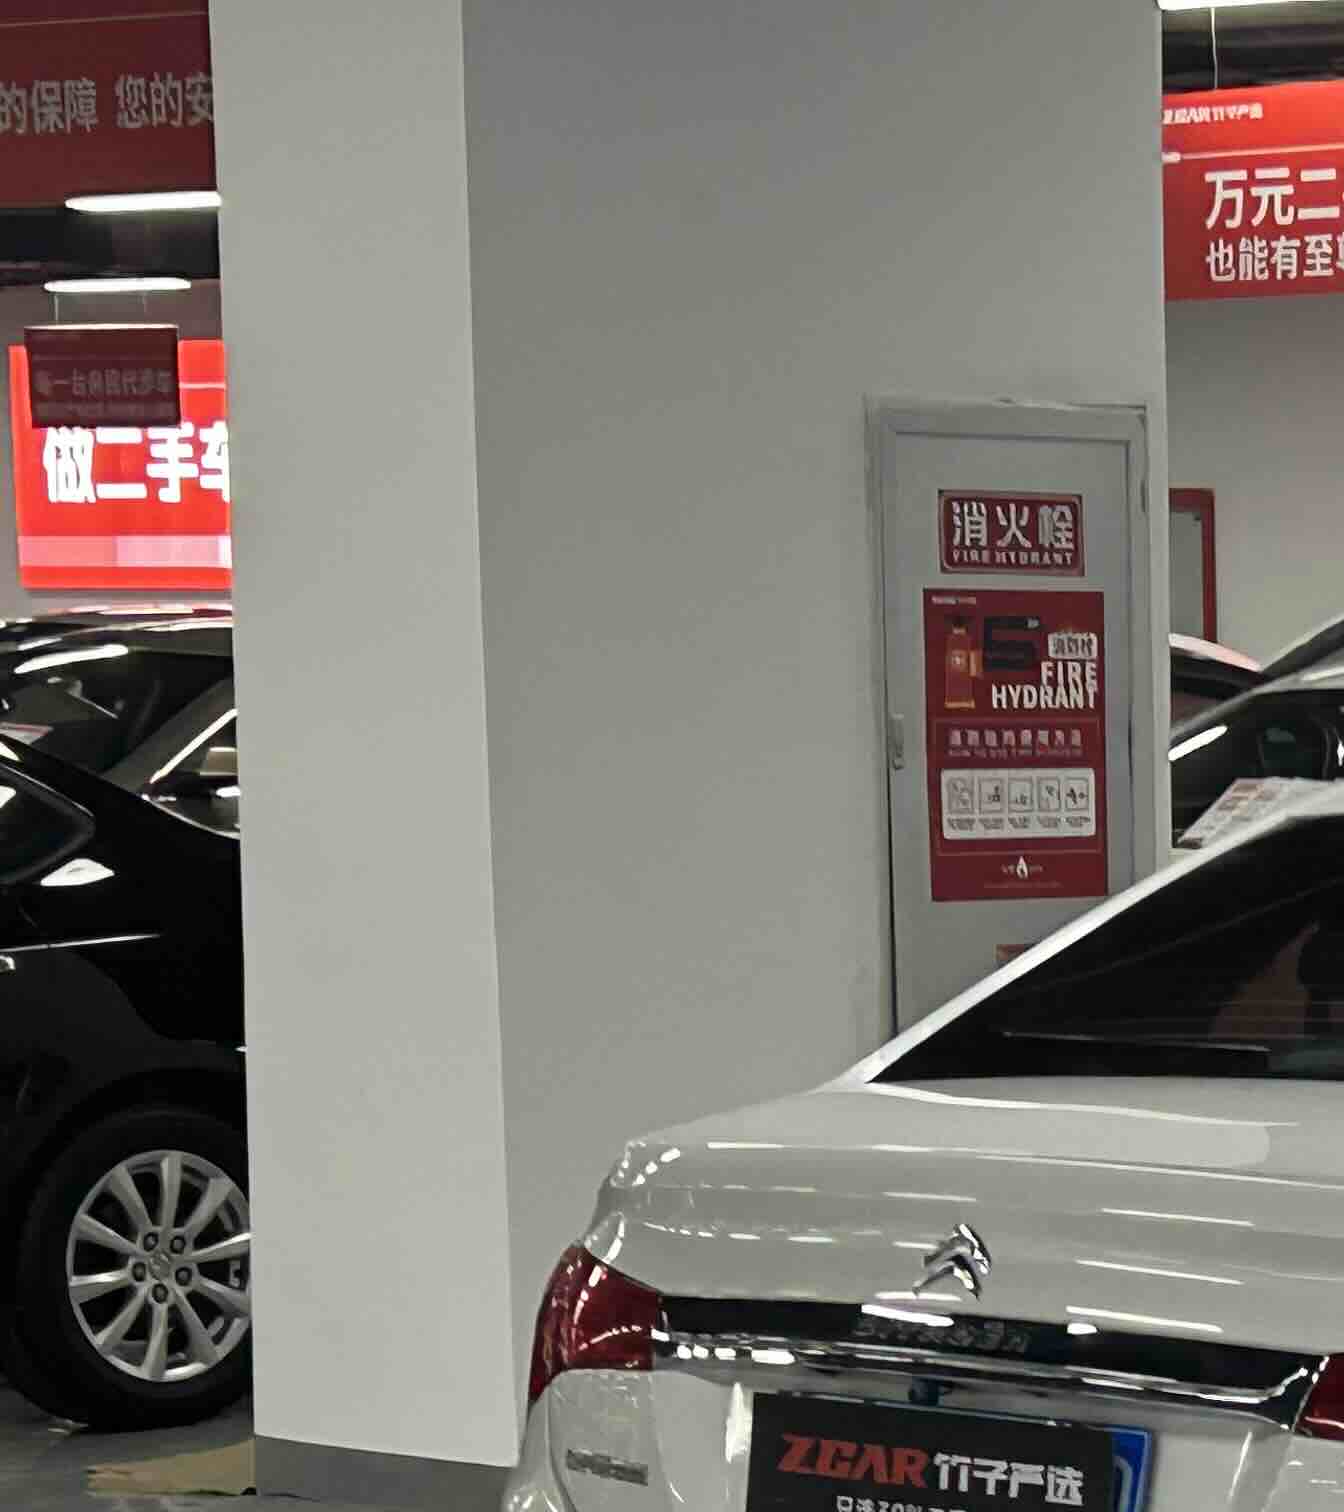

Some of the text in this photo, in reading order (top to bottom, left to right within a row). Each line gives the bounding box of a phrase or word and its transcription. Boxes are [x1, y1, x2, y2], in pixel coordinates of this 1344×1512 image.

[1041, 660, 1098, 688] FIRE
[991, 684, 1097, 709] HYDRANT
[933, 1451, 1085, 1507] 竹子严选
